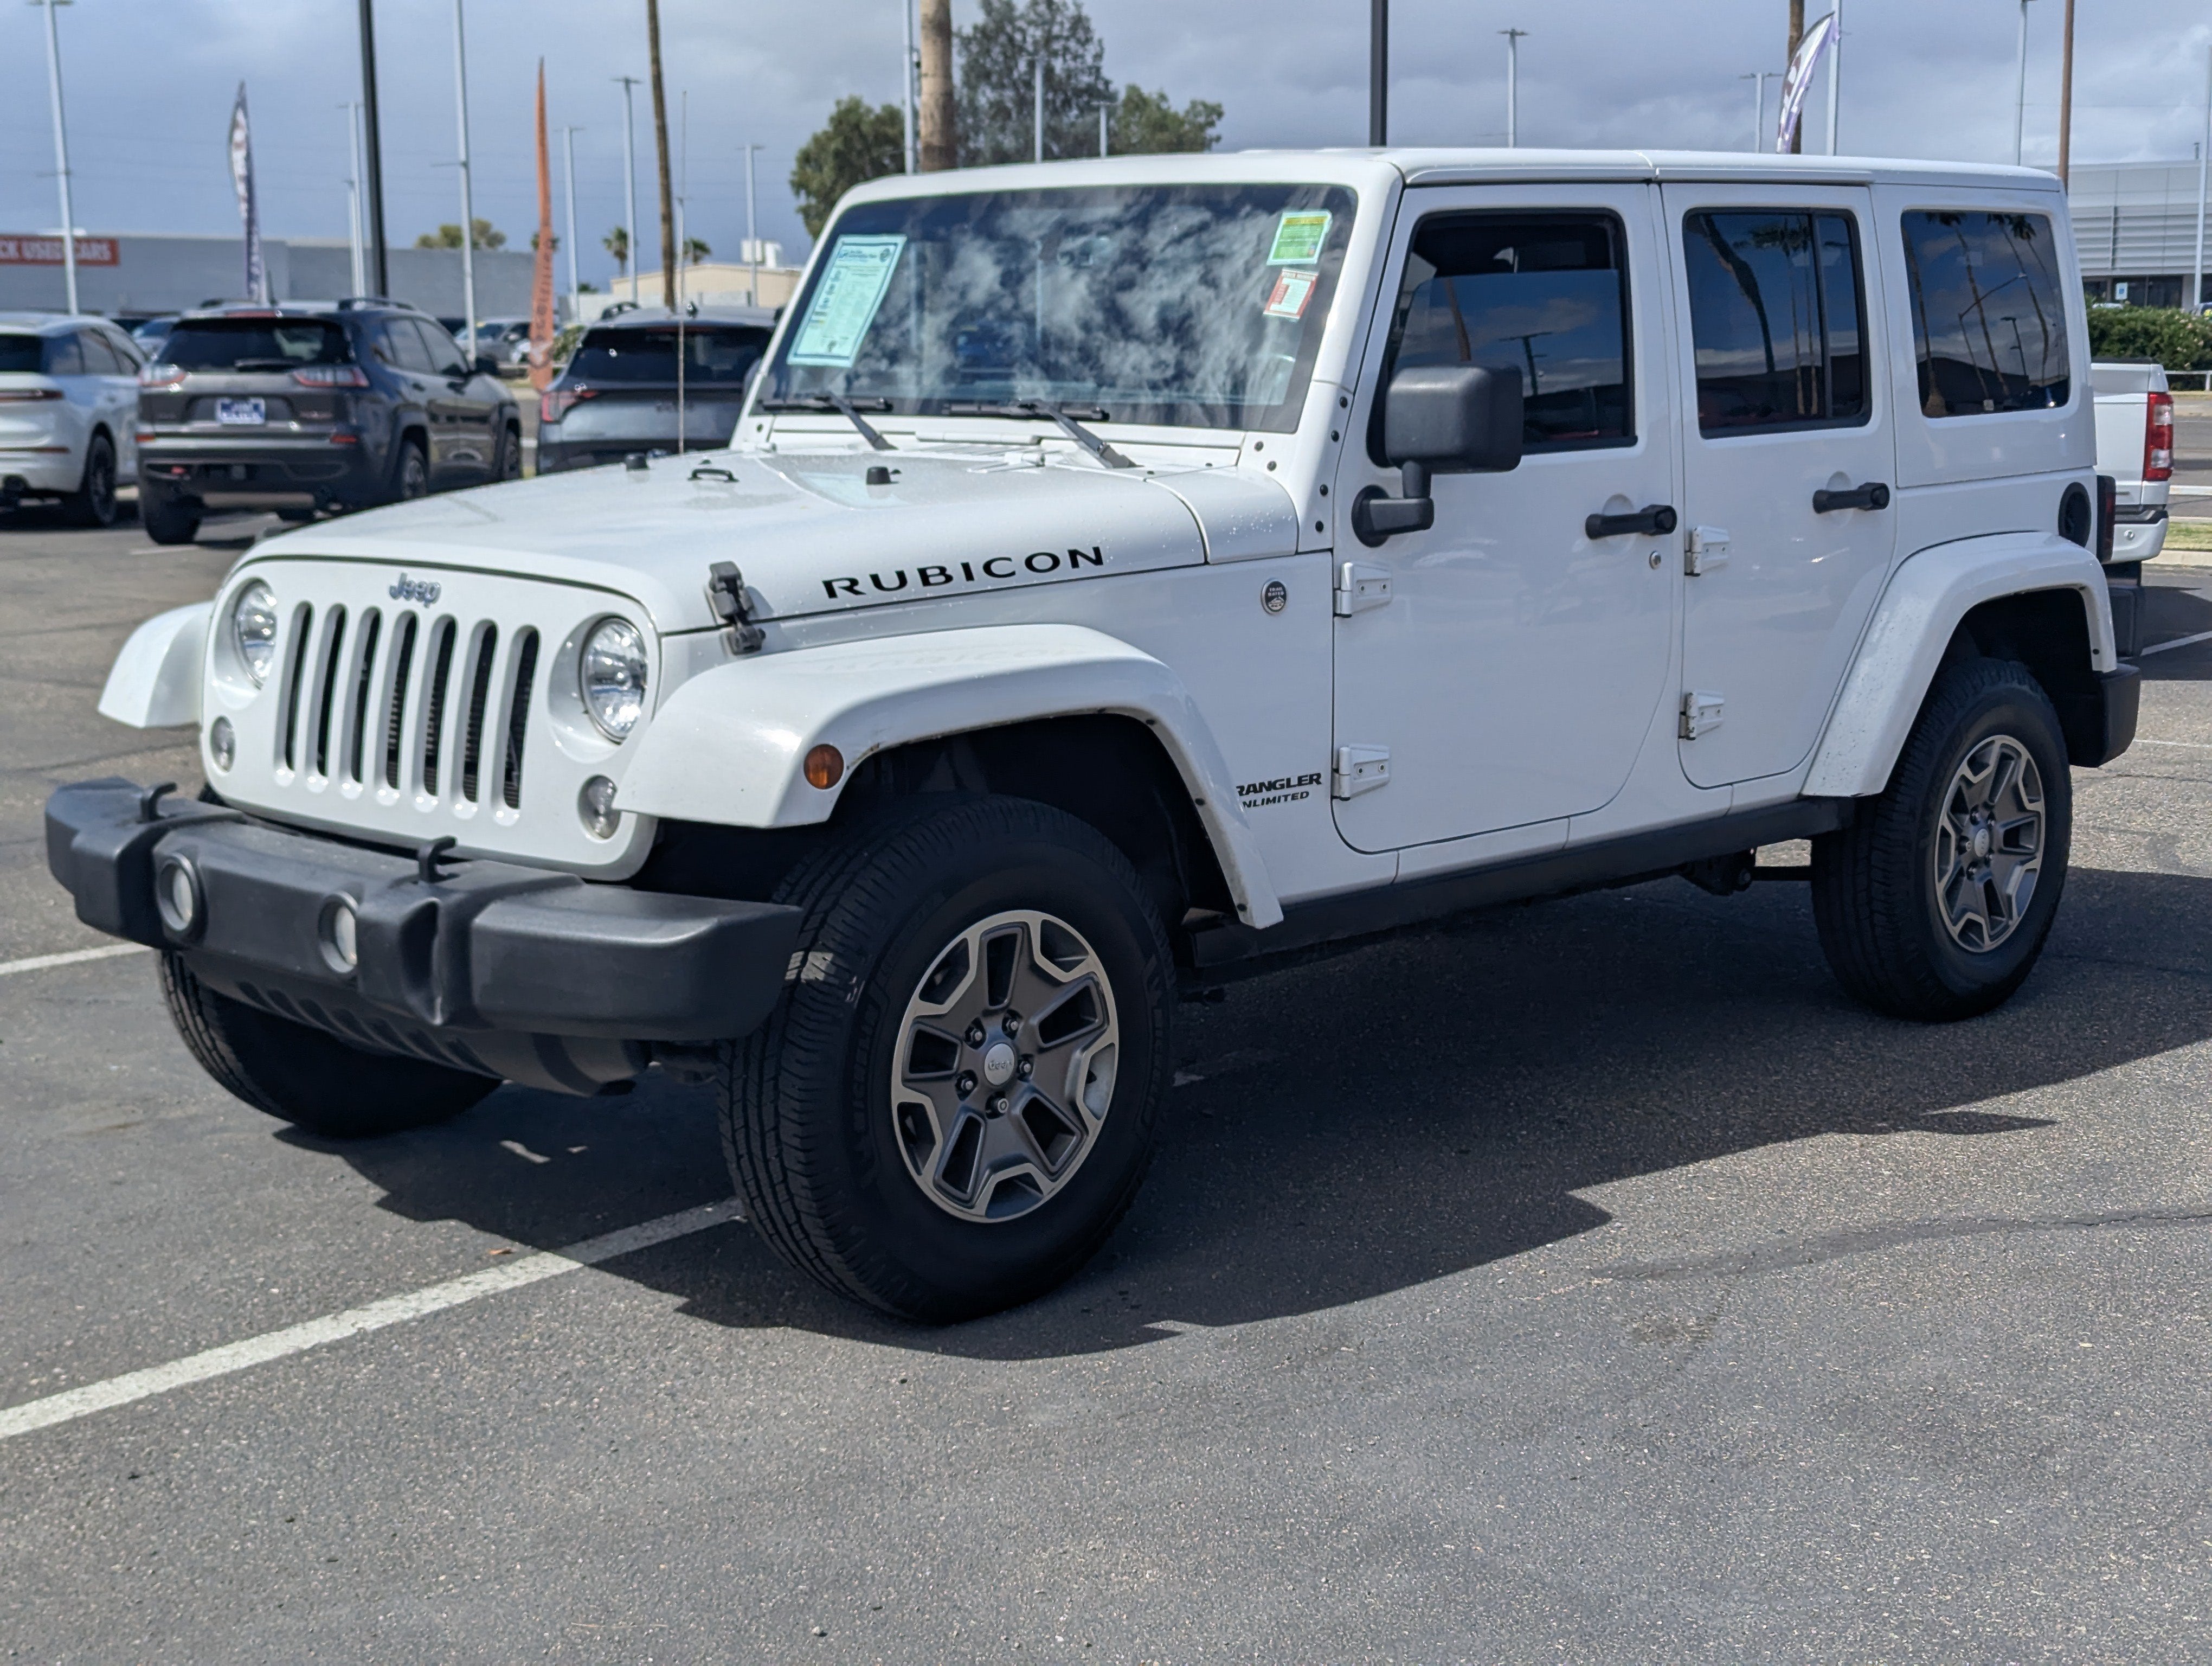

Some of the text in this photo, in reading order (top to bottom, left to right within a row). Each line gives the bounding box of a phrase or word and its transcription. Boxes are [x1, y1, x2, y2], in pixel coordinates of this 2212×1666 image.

[22, 241, 66, 260] USED
[74, 242, 110, 261] CARS
[389, 572, 441, 608] Jeep
[822, 546, 1104, 599] RUBICON
